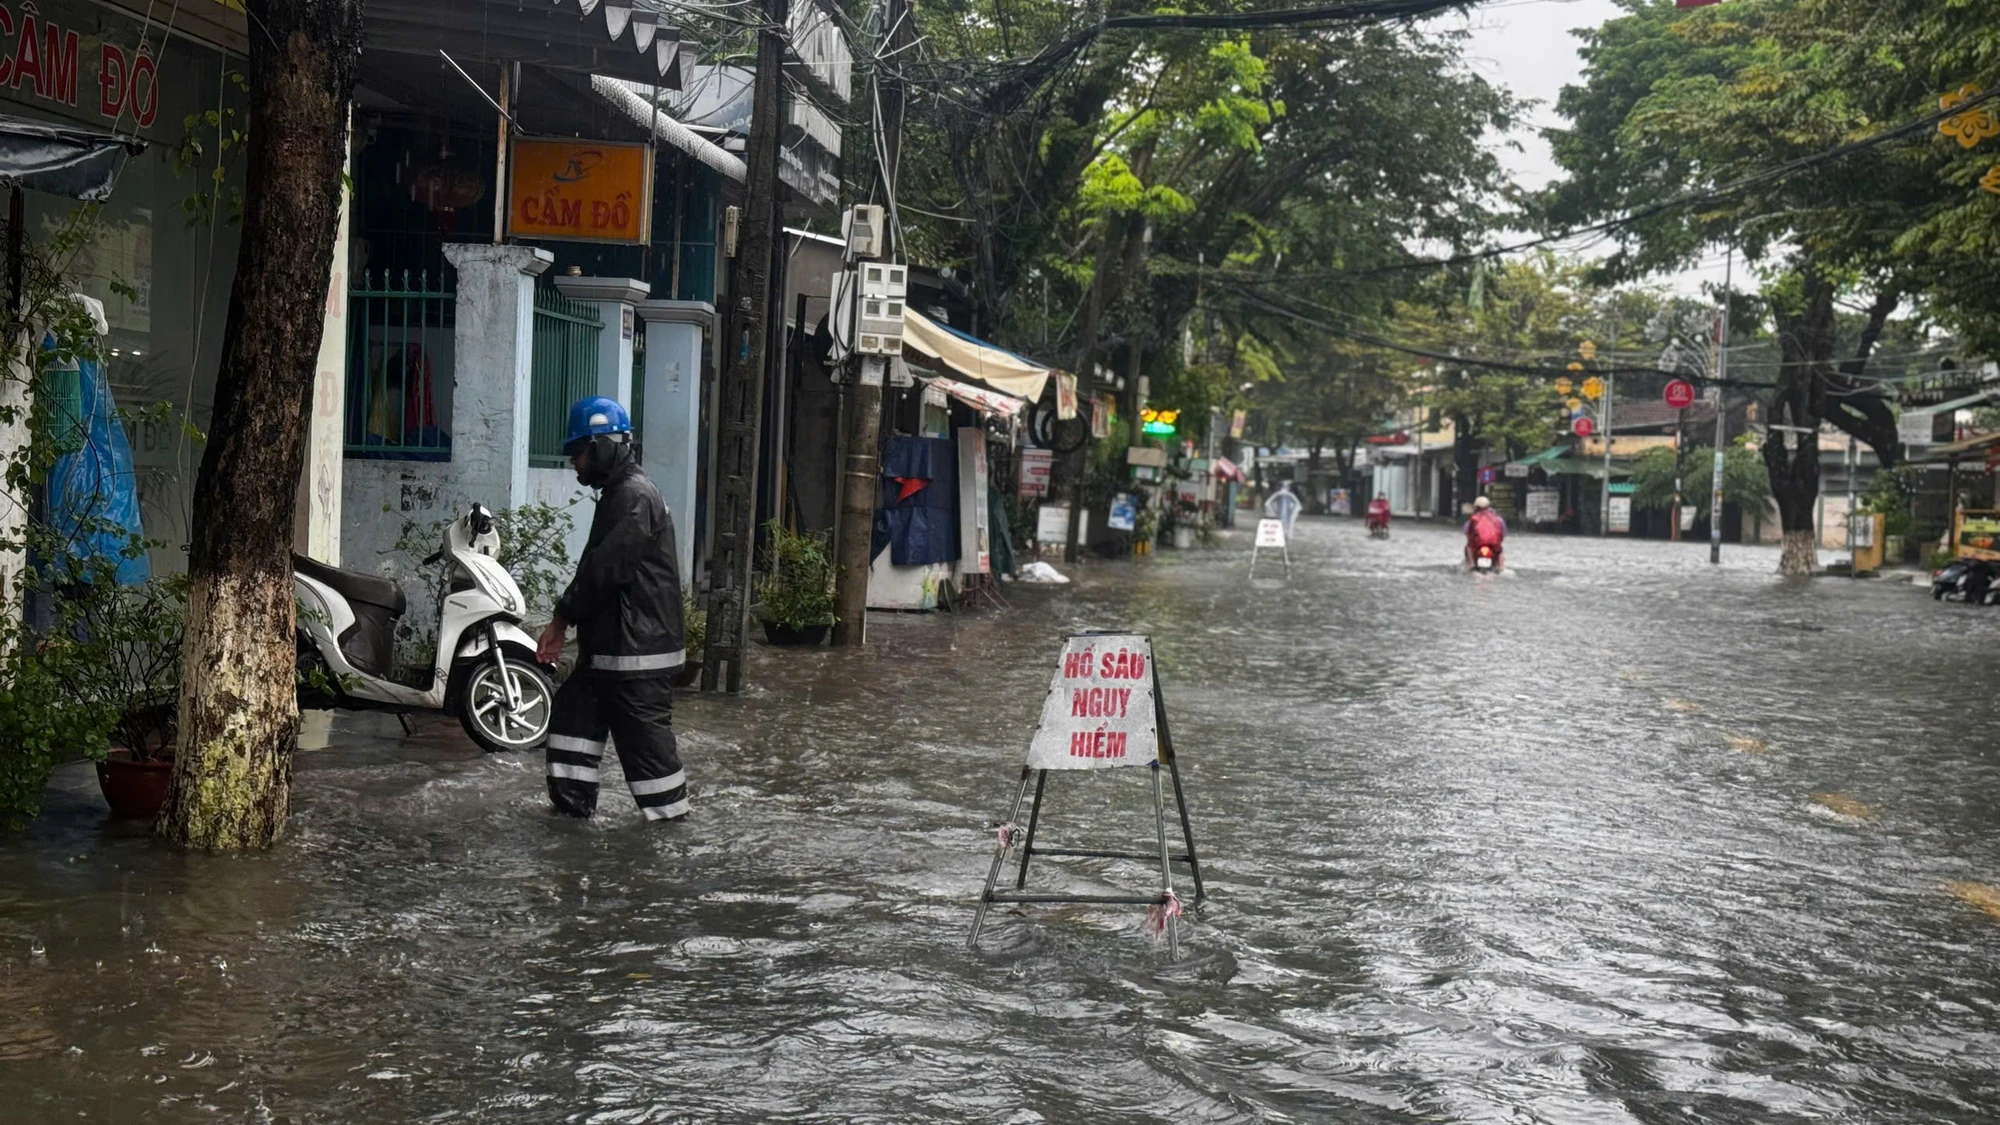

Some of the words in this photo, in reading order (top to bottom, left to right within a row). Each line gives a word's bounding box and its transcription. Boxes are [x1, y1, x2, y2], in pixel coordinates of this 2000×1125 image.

[589, 190, 632, 230] ĐỒ
[1065, 643, 1096, 679] HỐ
[1100, 647, 1146, 680] SÂU
[1072, 688, 1131, 718] NGUY
[1070, 721, 1127, 758] HIỂM
